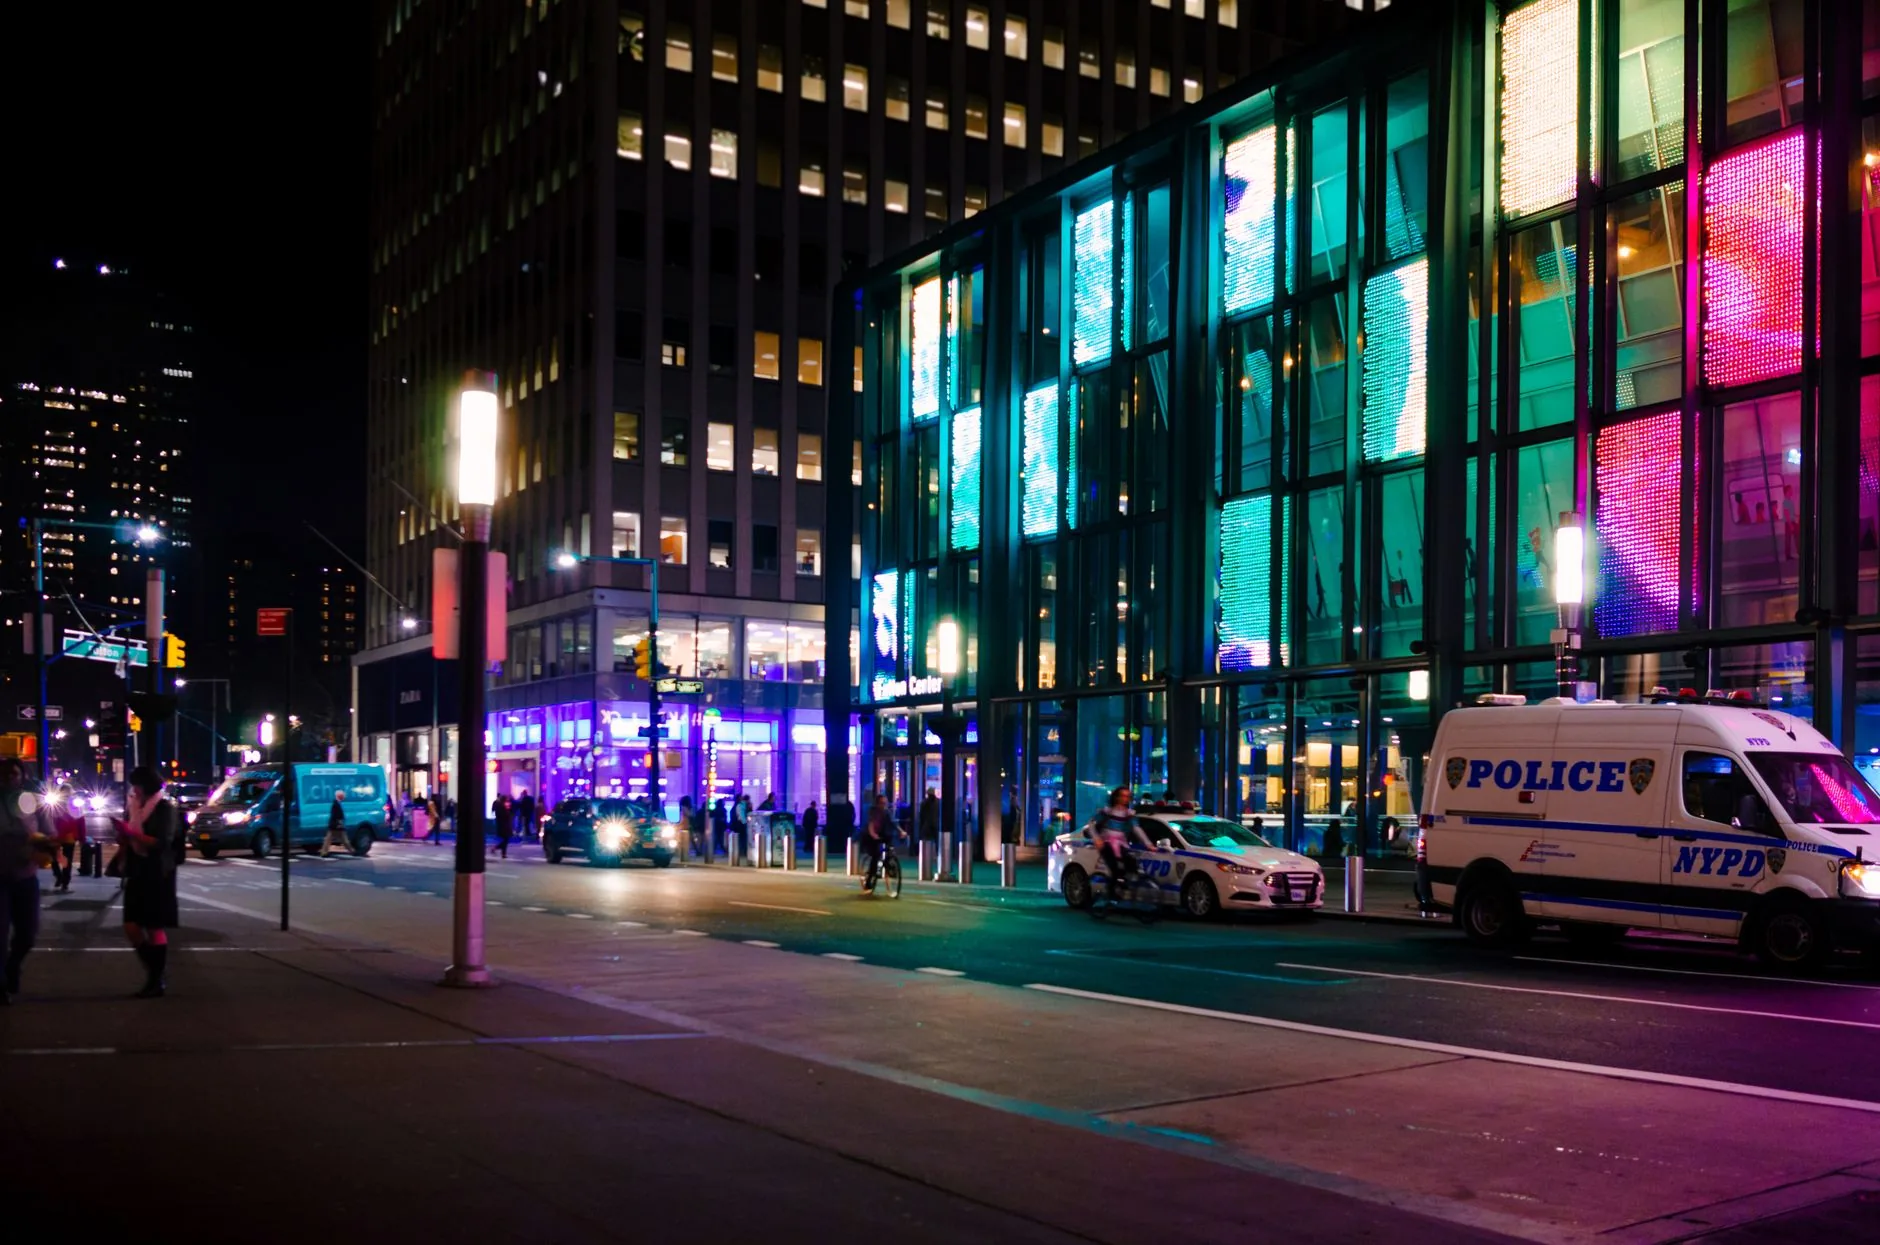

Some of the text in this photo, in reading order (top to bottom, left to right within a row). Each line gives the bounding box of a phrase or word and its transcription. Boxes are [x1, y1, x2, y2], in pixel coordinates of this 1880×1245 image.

[1746, 737, 1771, 746] NYPD
[1467, 759, 1626, 792] POLICE
[1785, 839, 1817, 853] POLICE
[1137, 858, 1172, 877] YPD
[1673, 846, 1765, 877] NYPD
